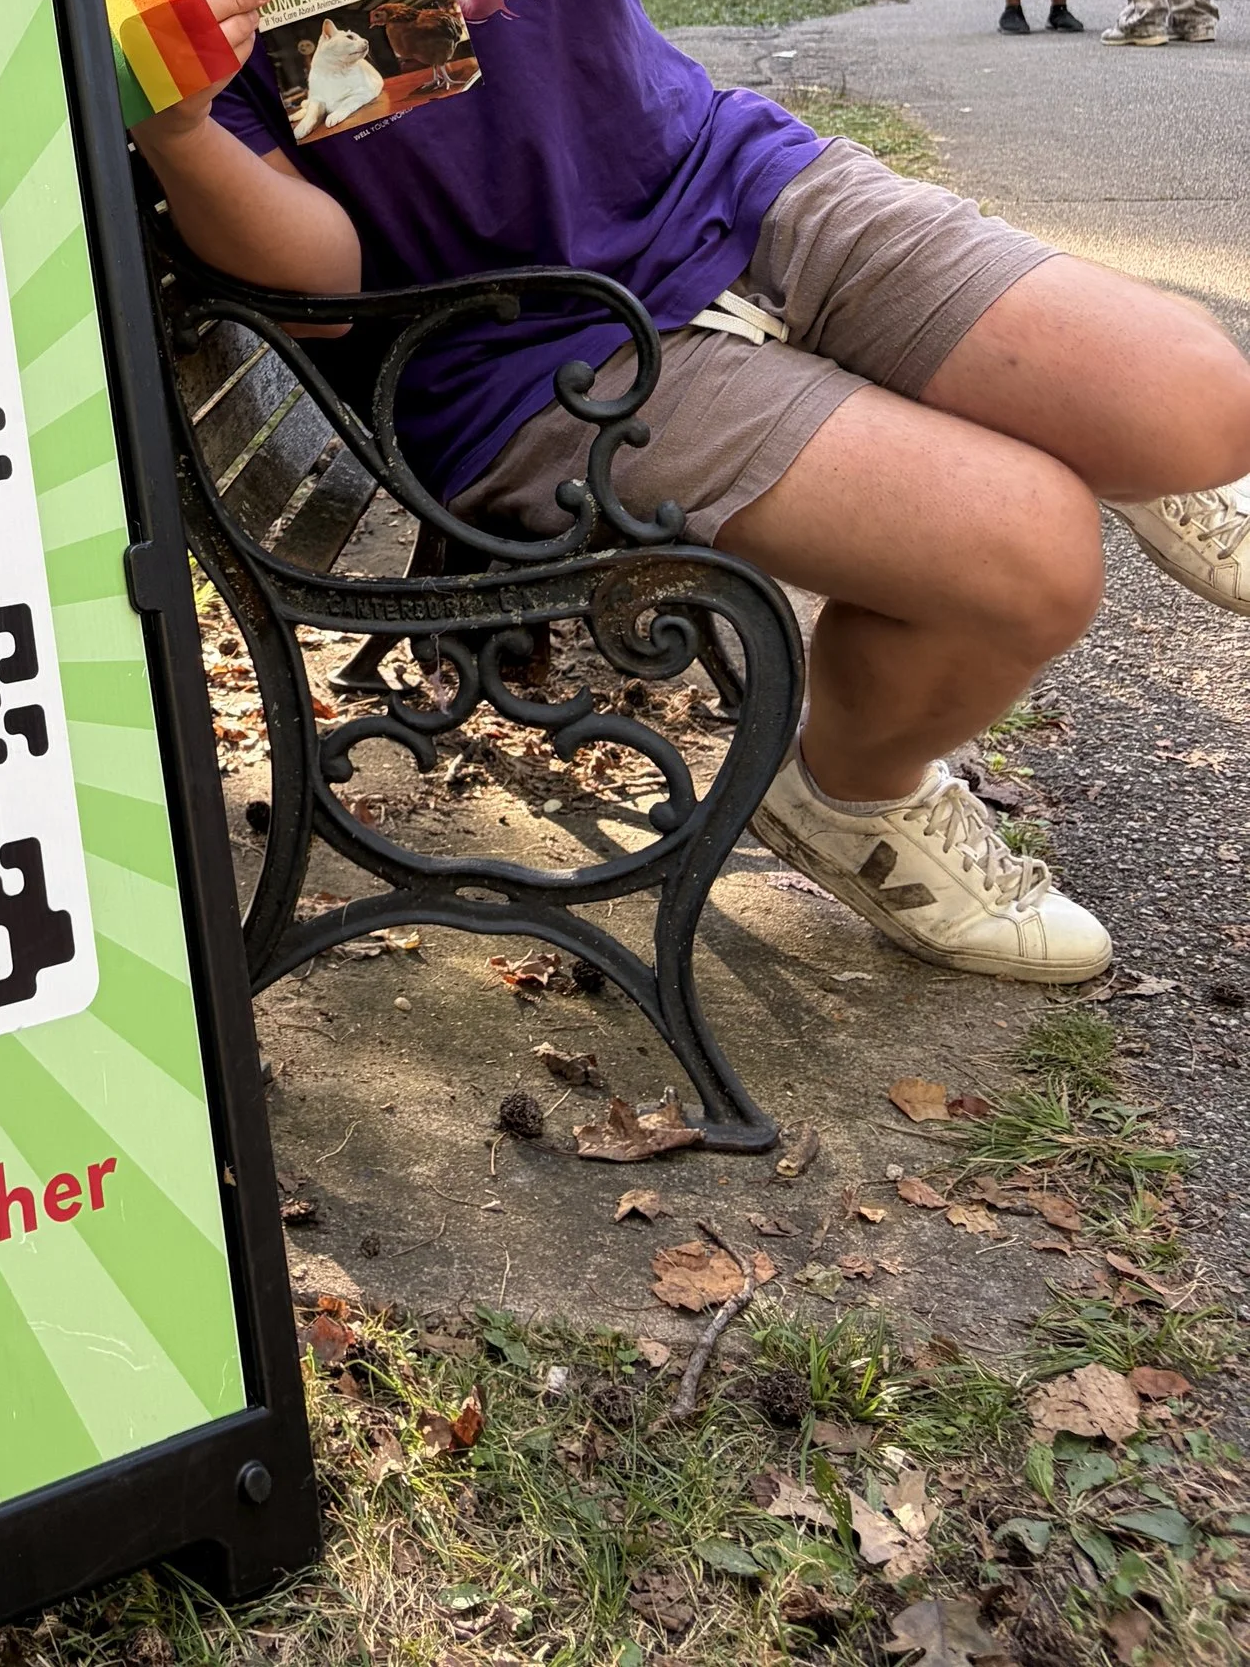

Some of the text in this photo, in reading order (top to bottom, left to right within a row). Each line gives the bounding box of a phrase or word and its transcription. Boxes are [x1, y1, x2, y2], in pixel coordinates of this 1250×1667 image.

[264, 18, 270, 26] If
[271, 16, 283, 25] You
[283, 11, 297, 21] Care
[298, 4, 316, 17] About
[353, 129, 370, 141] WELL
[371, 119, 390, 132] YOUR
